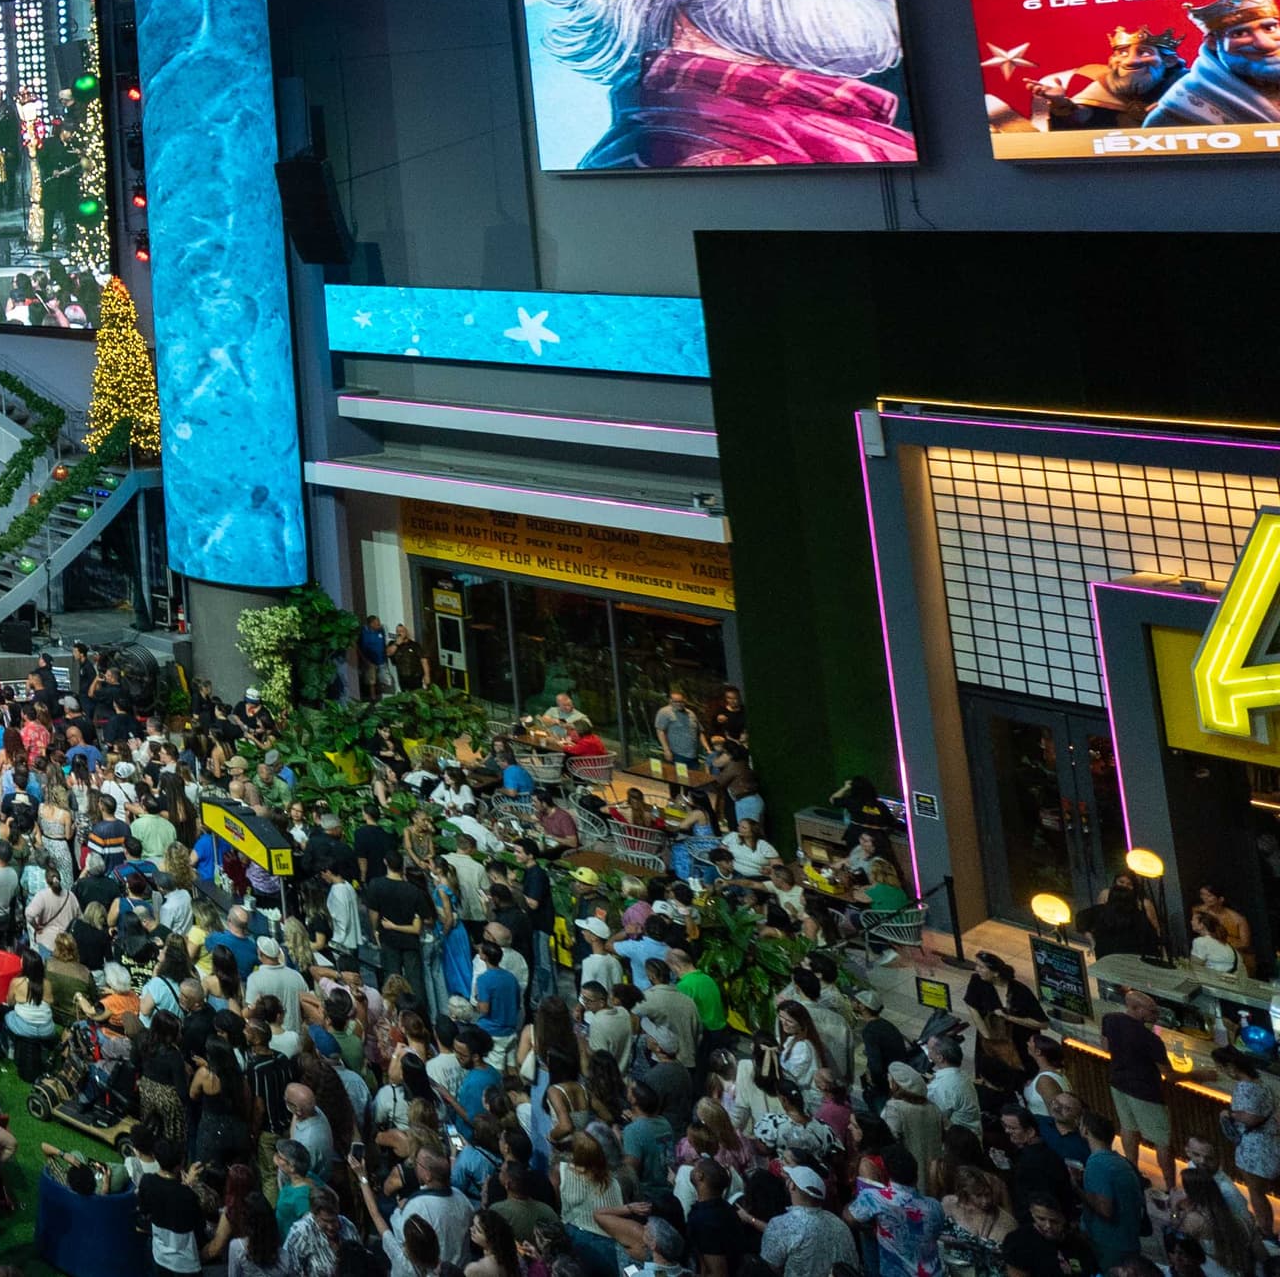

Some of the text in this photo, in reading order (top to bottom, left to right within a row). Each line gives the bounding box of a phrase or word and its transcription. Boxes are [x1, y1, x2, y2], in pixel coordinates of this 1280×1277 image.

[1023, 0, 1044, 10] 6
[499, 548, 532, 566] FLOR
[615, 570, 673, 589] FRANCISCO
[676, 581, 717, 597] LINDOR
[690, 561, 731, 580] YADIE
